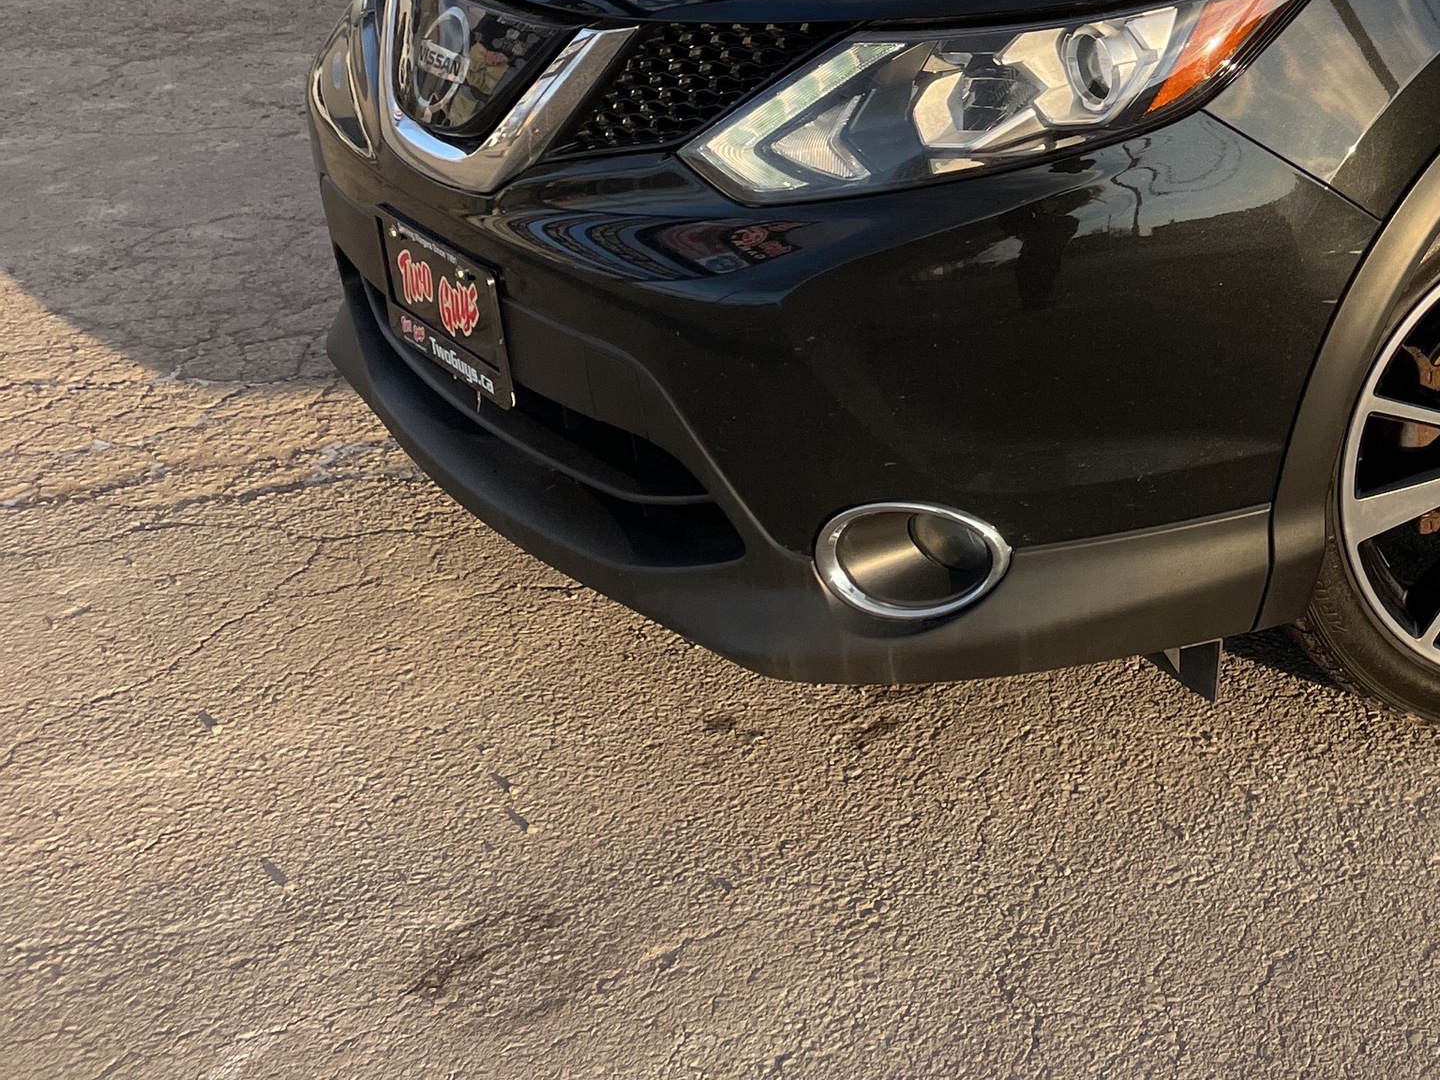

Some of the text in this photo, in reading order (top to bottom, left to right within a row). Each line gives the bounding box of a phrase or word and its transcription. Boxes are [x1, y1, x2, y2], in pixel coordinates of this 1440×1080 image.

[420, 44, 461, 77] NISSAN
[397, 249, 480, 338] Two Guys
[429, 336, 495, 394] TwoGuys.ca
